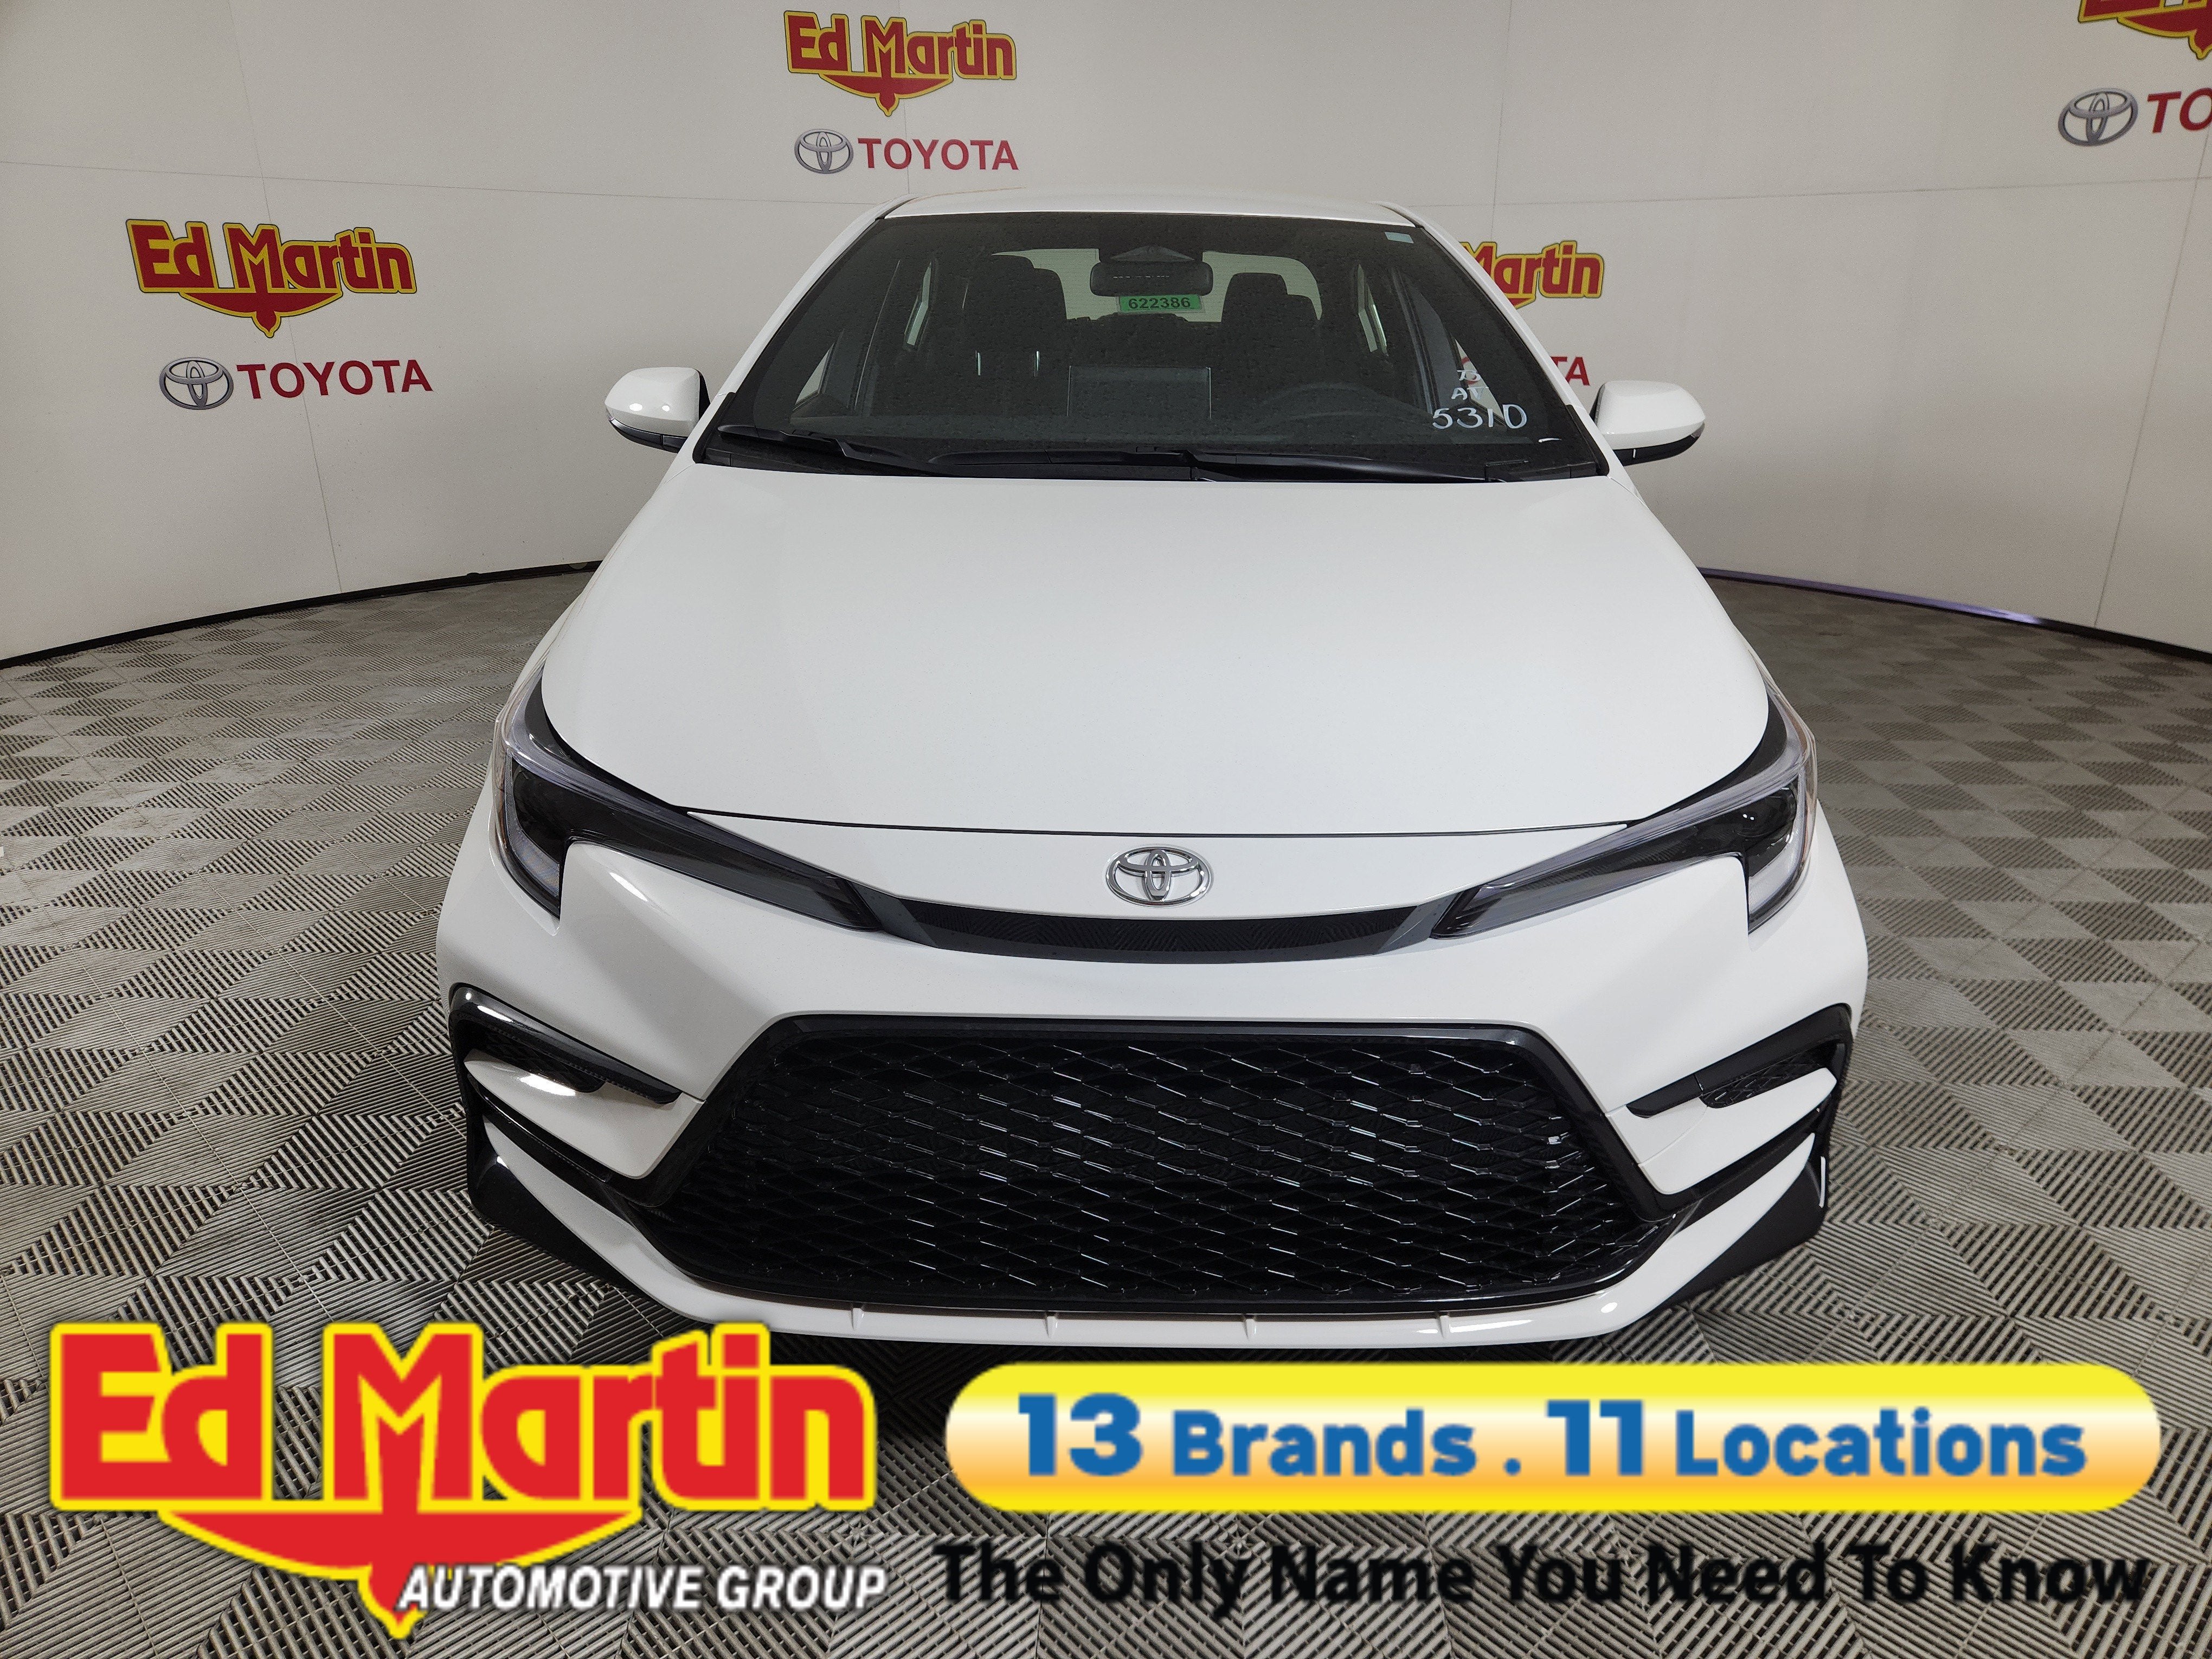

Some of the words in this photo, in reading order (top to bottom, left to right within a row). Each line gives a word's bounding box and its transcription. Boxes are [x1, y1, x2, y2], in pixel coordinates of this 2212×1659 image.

[785, 11, 849, 73] Ed
[861, 16, 1017, 80] Martin
[858, 138, 1019, 170] TOYOTA
[126, 219, 218, 293] Ed
[223, 223, 417, 294] Martin
[1128, 297, 1192, 310] 622386
[236, 359, 433, 400] TOYOTA
